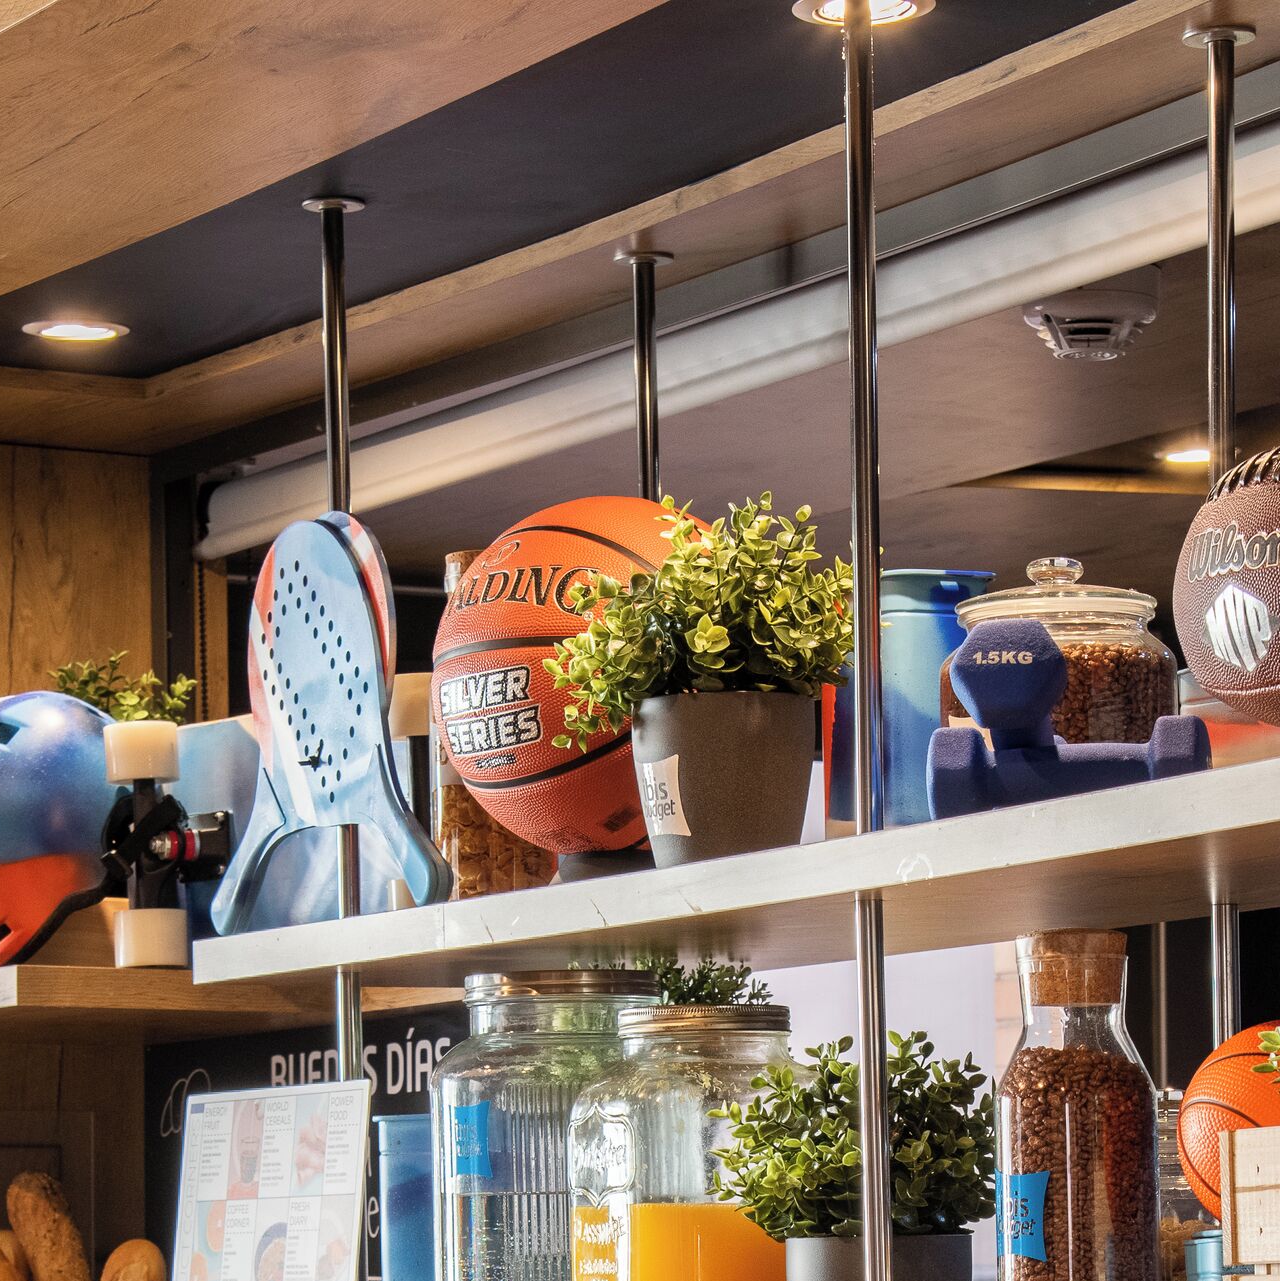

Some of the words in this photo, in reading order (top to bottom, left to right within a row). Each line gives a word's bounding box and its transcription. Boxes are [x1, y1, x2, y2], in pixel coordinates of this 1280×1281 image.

[1204, 584, 1272, 673] MVP
[972, 651, 1033, 665] 1.5KG
[441, 668, 528, 715] SILVER
[447, 709, 540, 755] SERIES
[643, 777, 668, 802] ibis
[271, 1044, 378, 1097] BUENS
[266, 1101, 289, 1112] WORLD
[330, 1095, 354, 1107] POWER
[265, 1114, 292, 1126] CEREALS
[330, 1110, 348, 1121] FOOD
